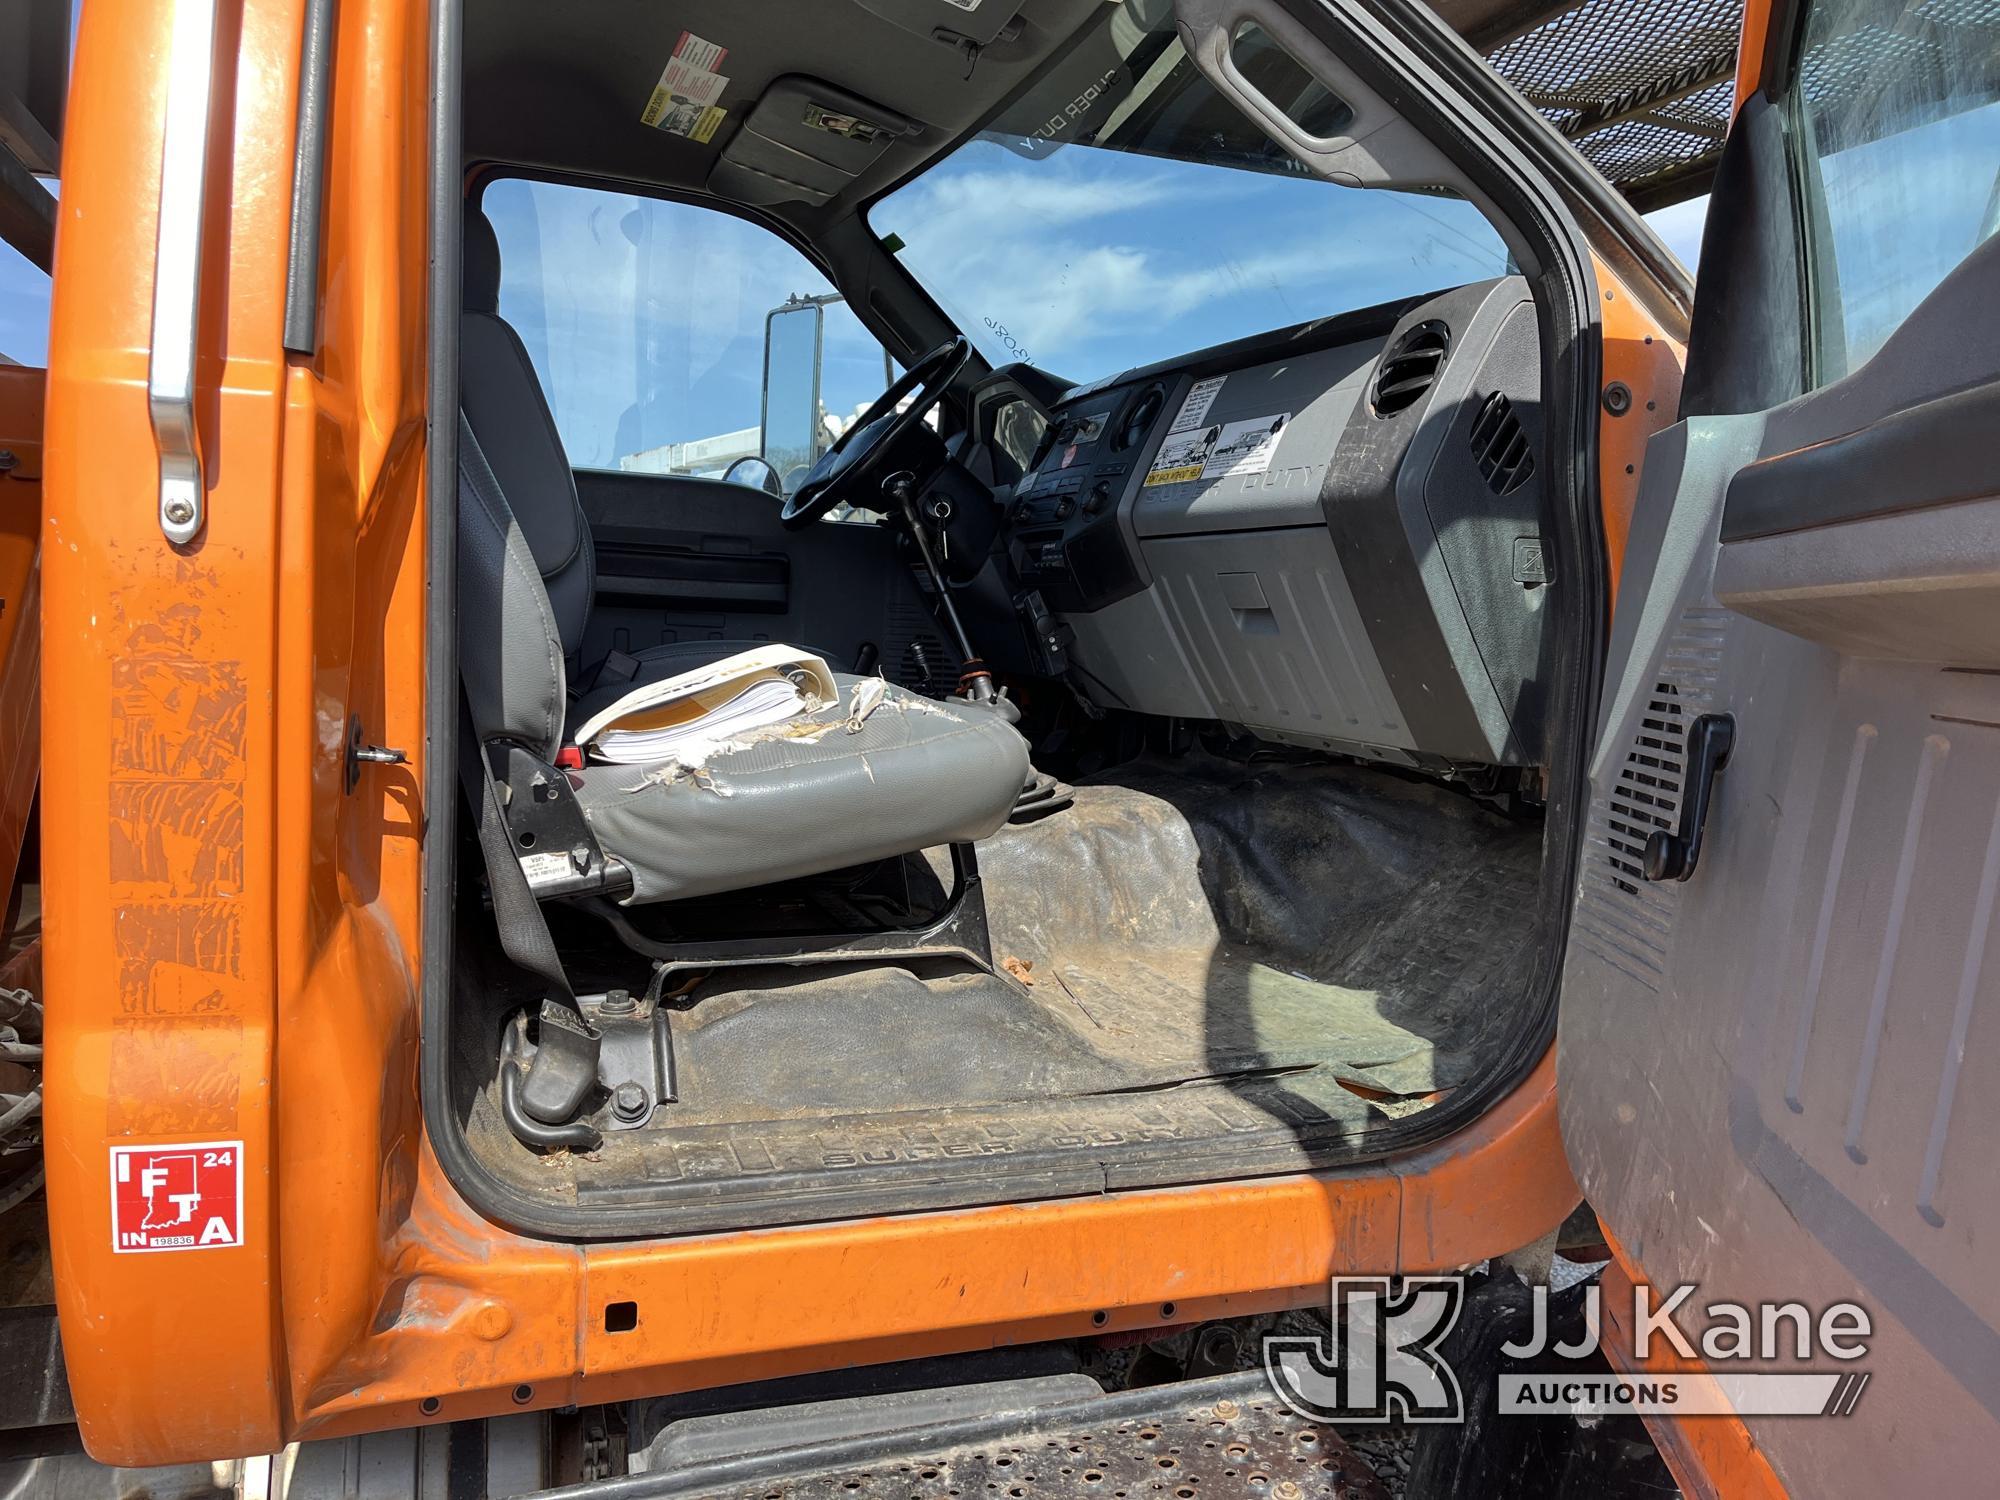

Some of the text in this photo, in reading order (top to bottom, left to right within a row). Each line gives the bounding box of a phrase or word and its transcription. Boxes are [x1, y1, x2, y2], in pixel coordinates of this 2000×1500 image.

[203, 1152, 232, 1167] 24
[121, 1232, 193, 1246] IN 198836
